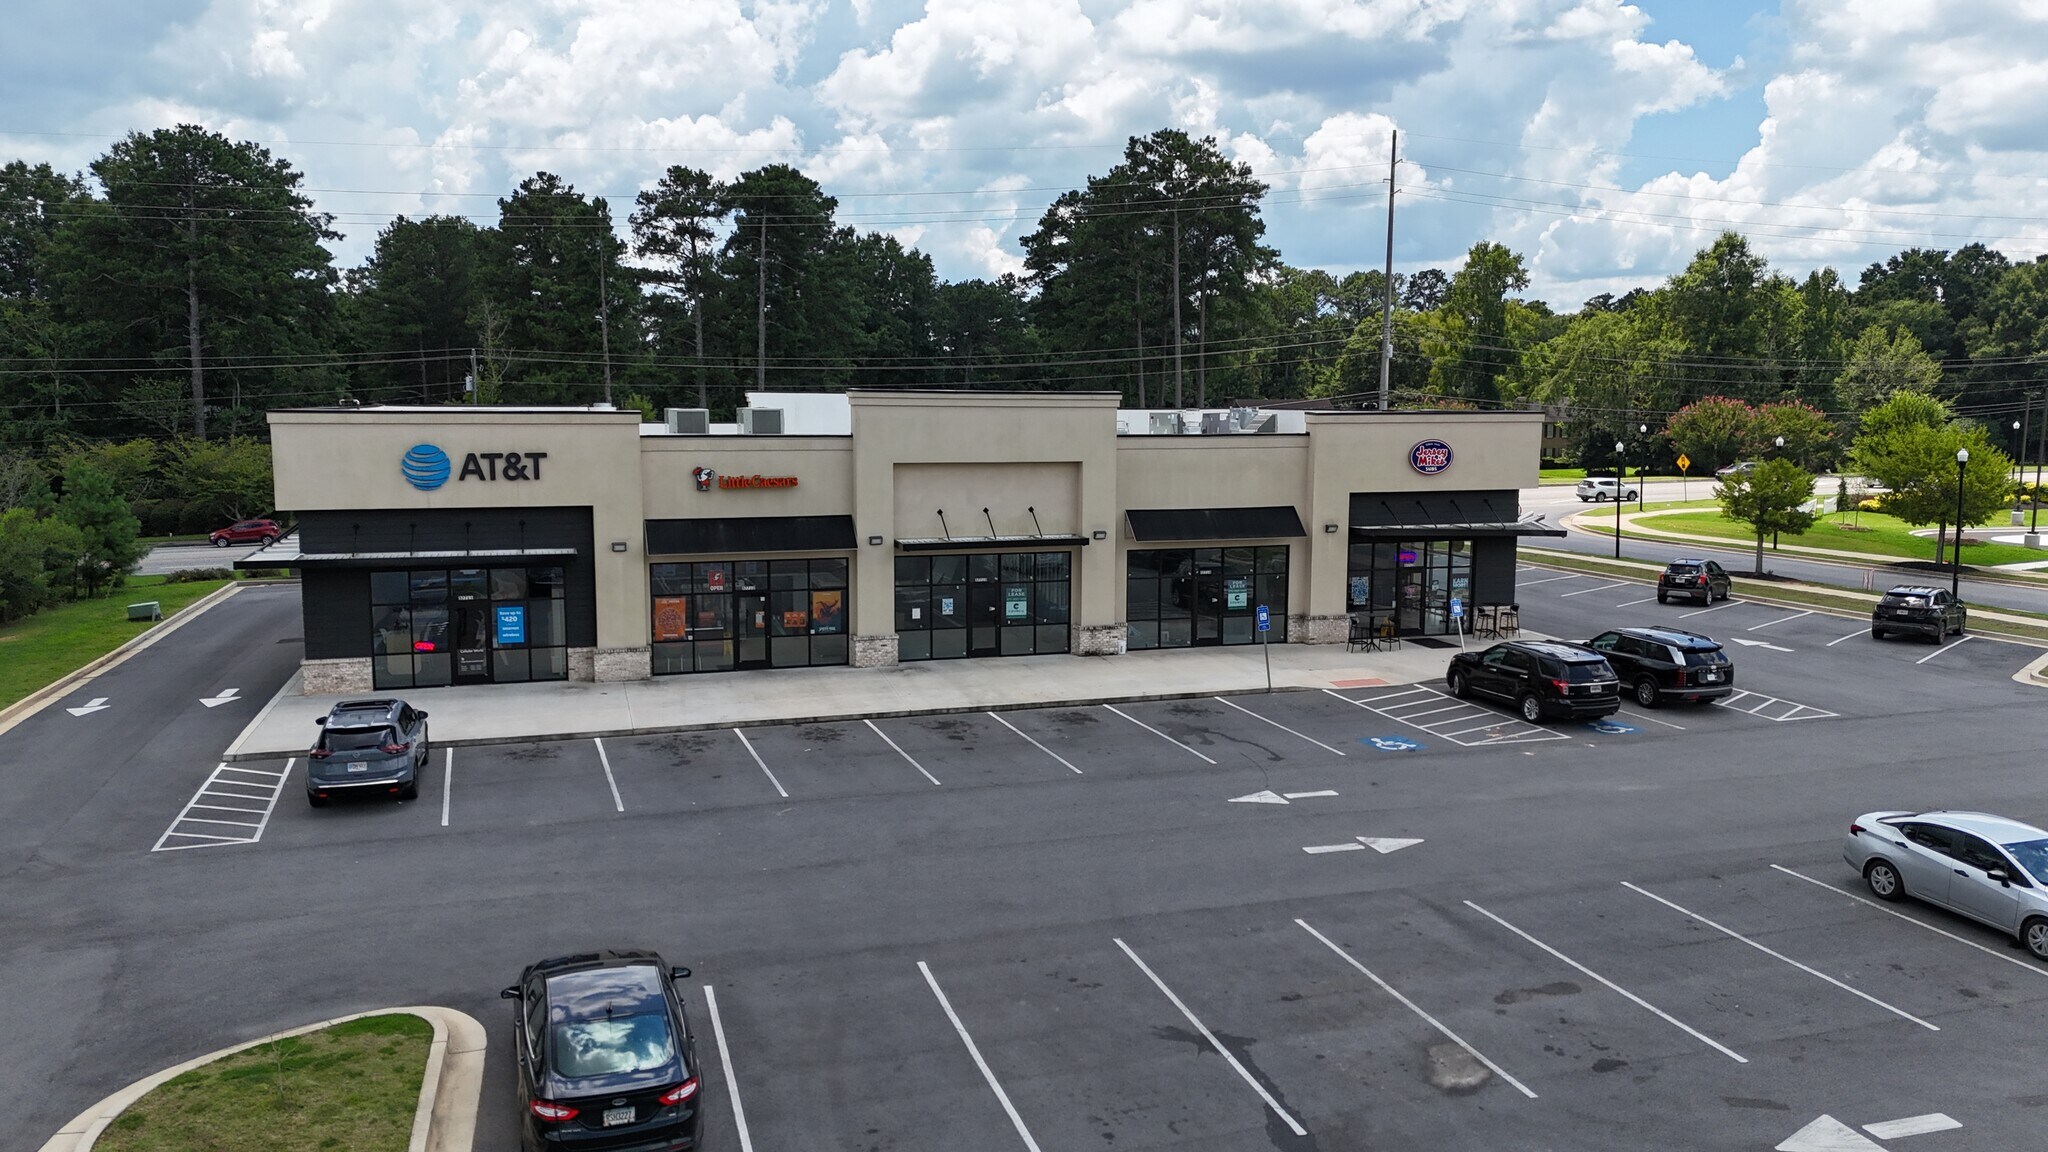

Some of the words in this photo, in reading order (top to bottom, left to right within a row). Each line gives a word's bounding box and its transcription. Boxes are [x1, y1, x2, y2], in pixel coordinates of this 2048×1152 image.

[1416, 446, 1448, 459] Jersey
[459, 452, 548, 481] AT&T
[719, 475, 750, 488] Little
[751, 474, 799, 488] Caesars
